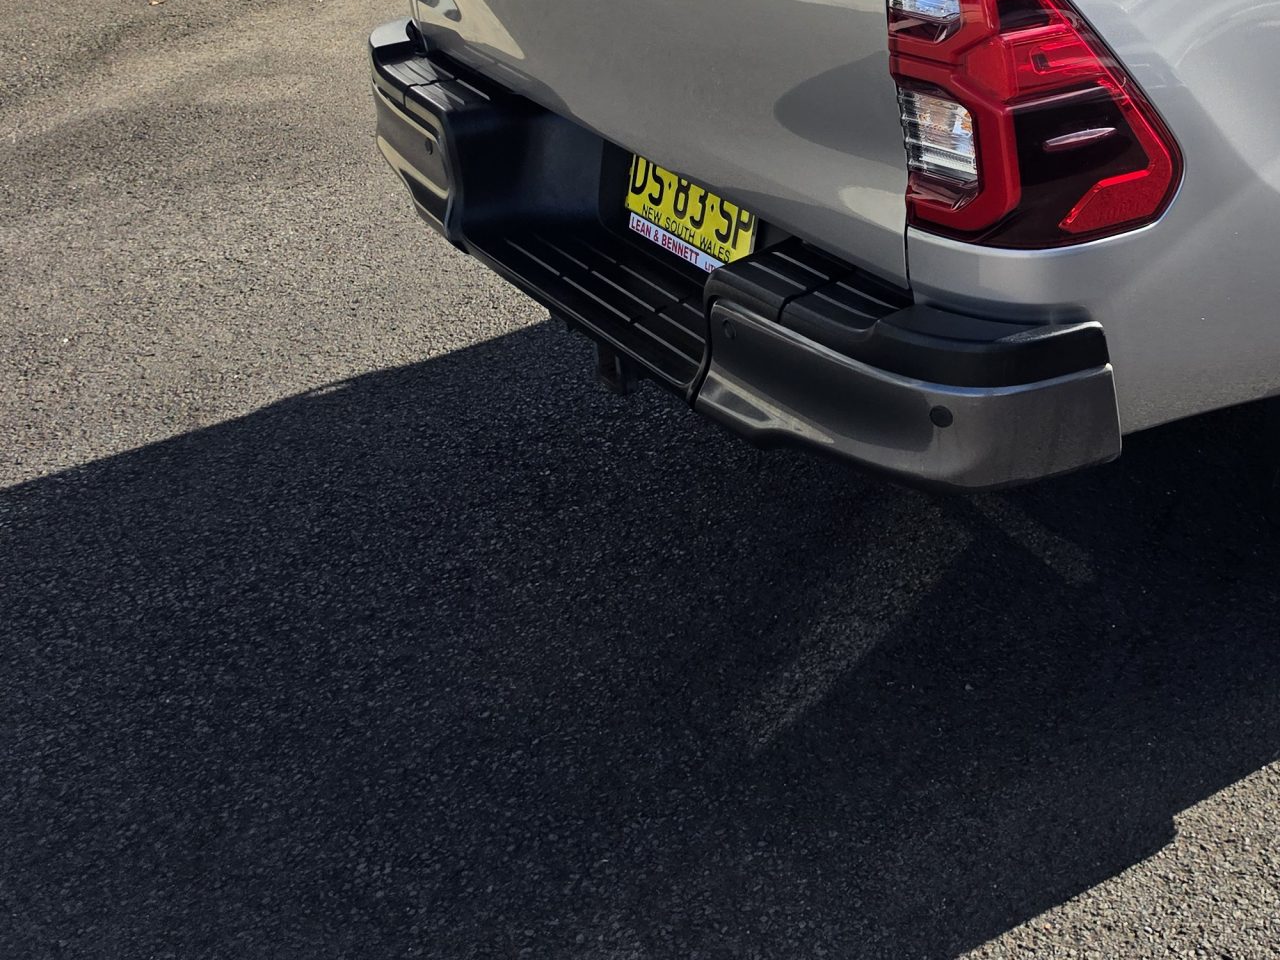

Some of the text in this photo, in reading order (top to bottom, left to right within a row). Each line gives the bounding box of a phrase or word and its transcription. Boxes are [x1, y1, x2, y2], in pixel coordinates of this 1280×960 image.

[631, 215, 652, 239] LEAN
[653, 228, 660, 243] &
[661, 233, 700, 265] BENNETT
[642, 203, 732, 262] NEW SOUTH WALES
